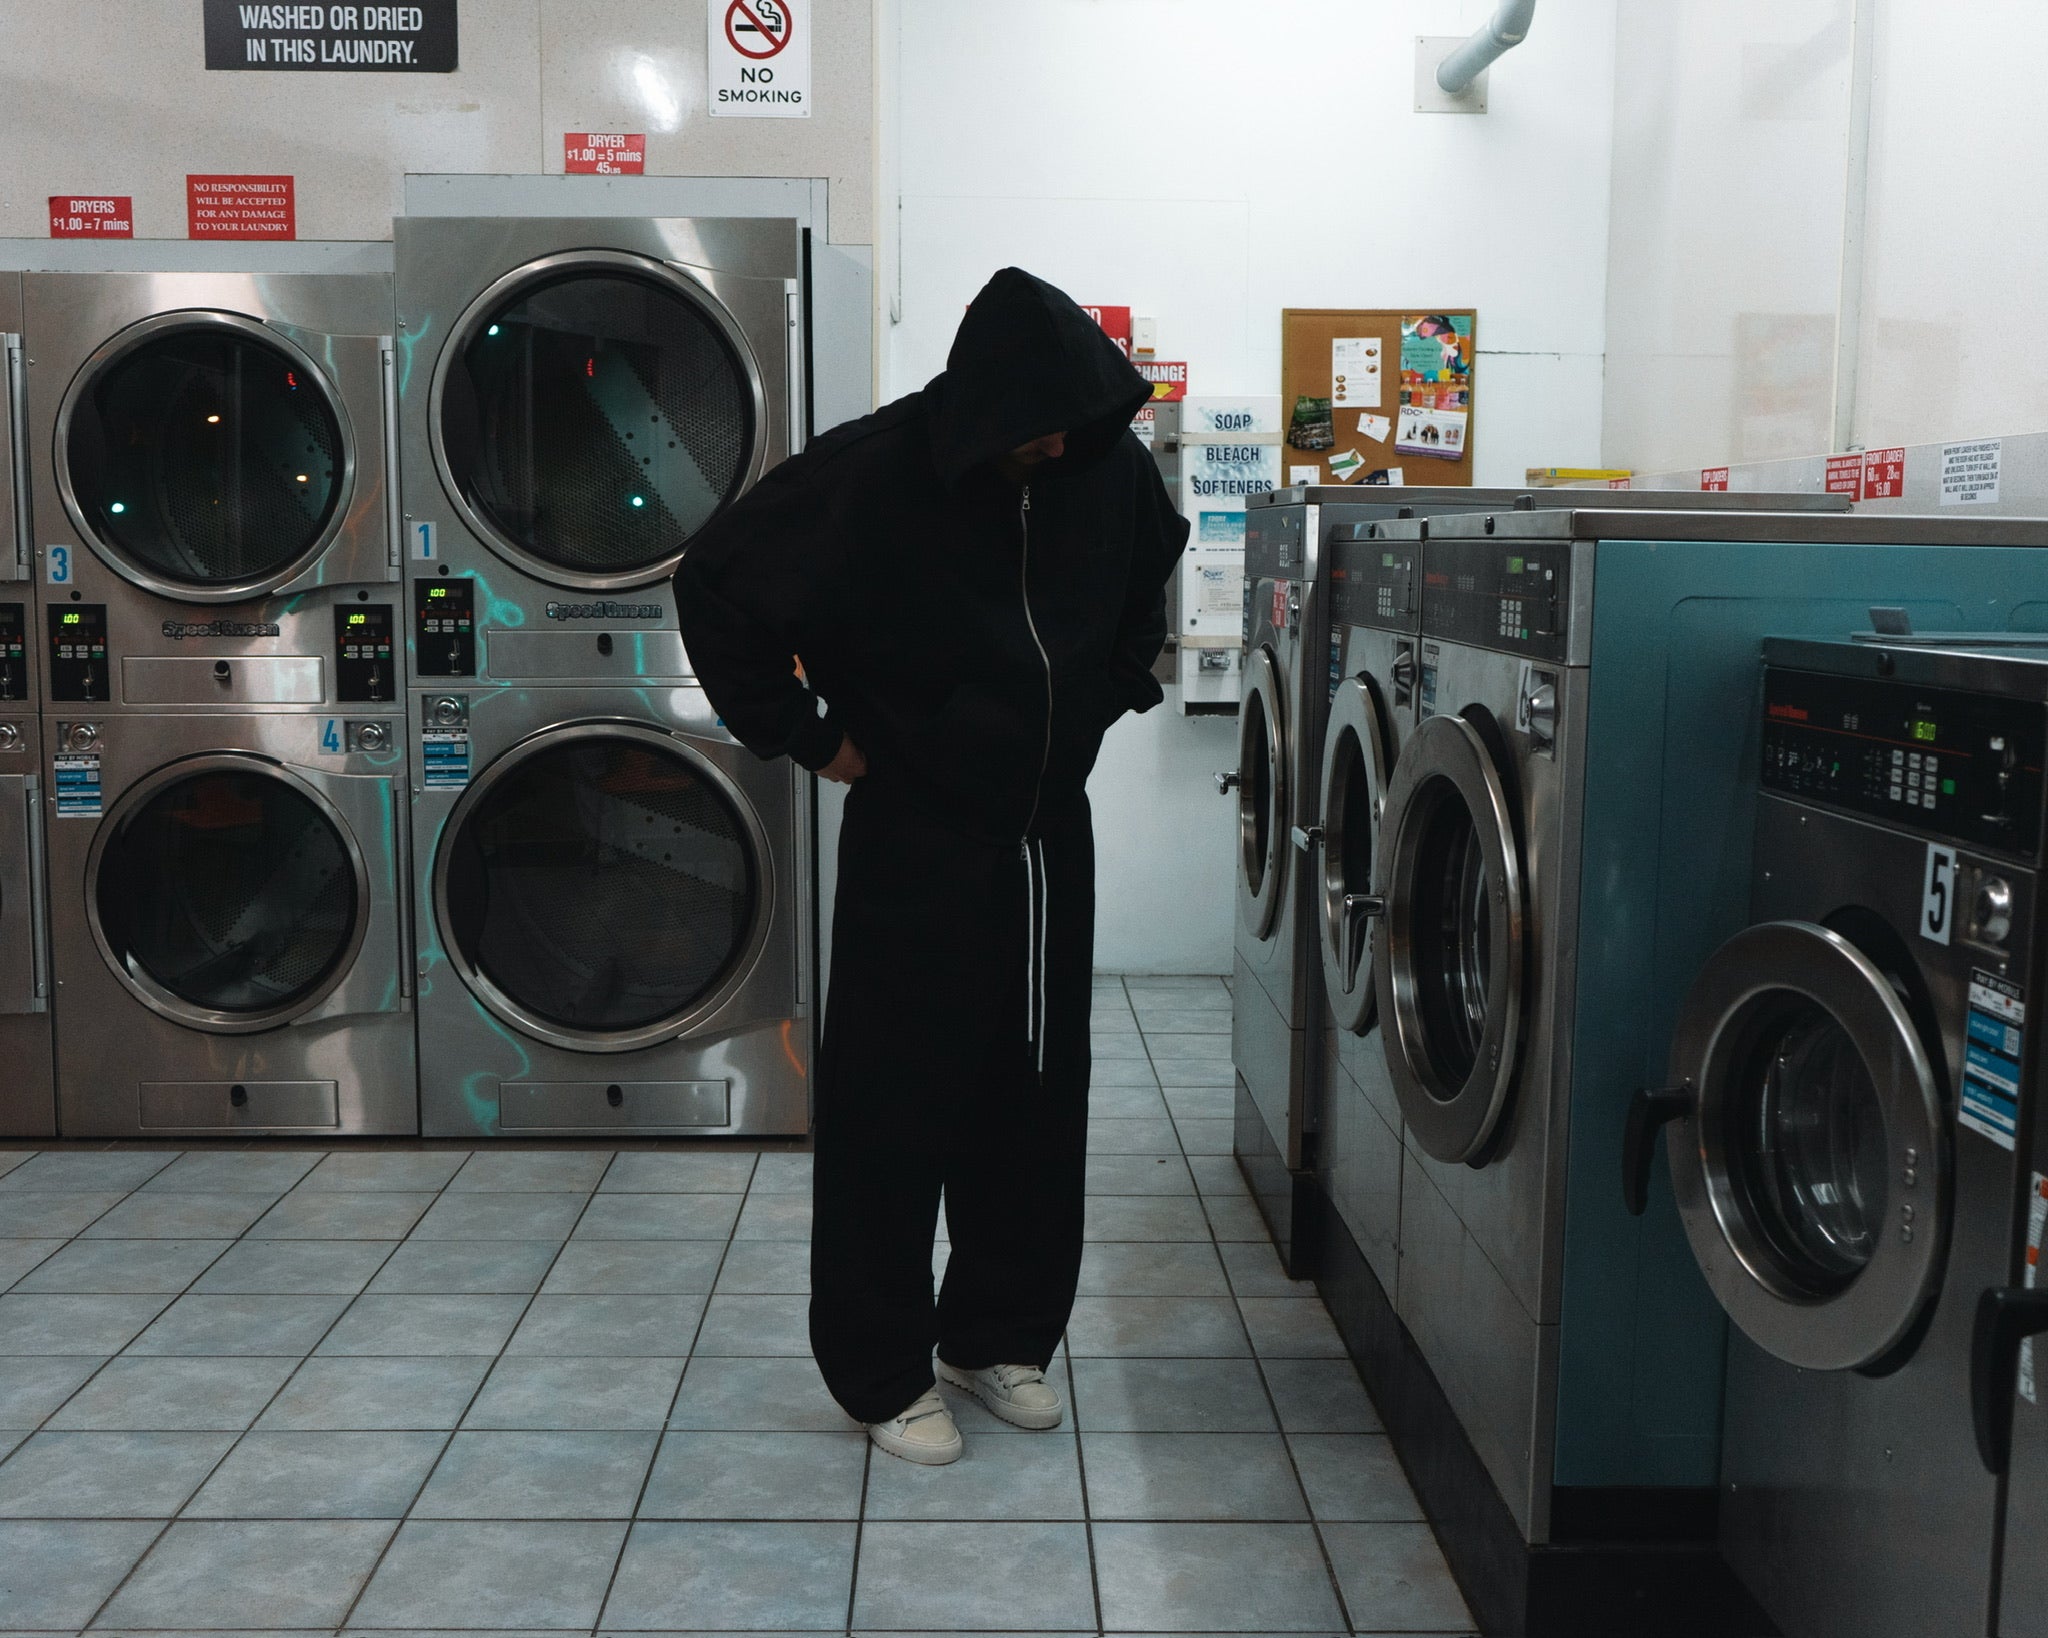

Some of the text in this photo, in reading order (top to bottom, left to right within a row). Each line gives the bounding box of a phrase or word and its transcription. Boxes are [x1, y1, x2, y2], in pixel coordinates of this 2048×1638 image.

[239, 5, 423, 31] WASHED OR DRIED
[246, 38, 418, 64] IN THIS LAUNDRY.
[741, 67, 773, 83] NO
[718, 89, 802, 103] SMOKING
[588, 134, 625, 148] DRYER
[567, 148, 596, 161] $1.00
[607, 149, 614, 162] 5
[616, 149, 642, 162] mins
[194, 183, 287, 193] NO RESPONSIBILITY
[70, 200, 115, 214] DRYERS
[196, 197, 286, 206] WILL BE ACCEPTED
[197, 210, 286, 218] FOR ANY DAMAGE
[53, 217, 82, 230] $1.00
[93, 218, 101, 230] 7
[103, 217, 130, 231] mins
[195, 223, 288, 231] TO YOUR LAUNDRY
[1215, 414, 1251, 429] SOAP
[1207, 447, 1260, 461] BLEACH
[1866, 449, 1904, 465] FRONT LOADER
[1193, 480, 1272, 494] SOFTENERS
[418, 523, 430, 557] 1
[52, 547, 68, 582] 3
[323, 720, 339, 752] 4
[1928, 852, 1949, 933] 5
[1976, 972, 2020, 998] PAY BY MOBILE
